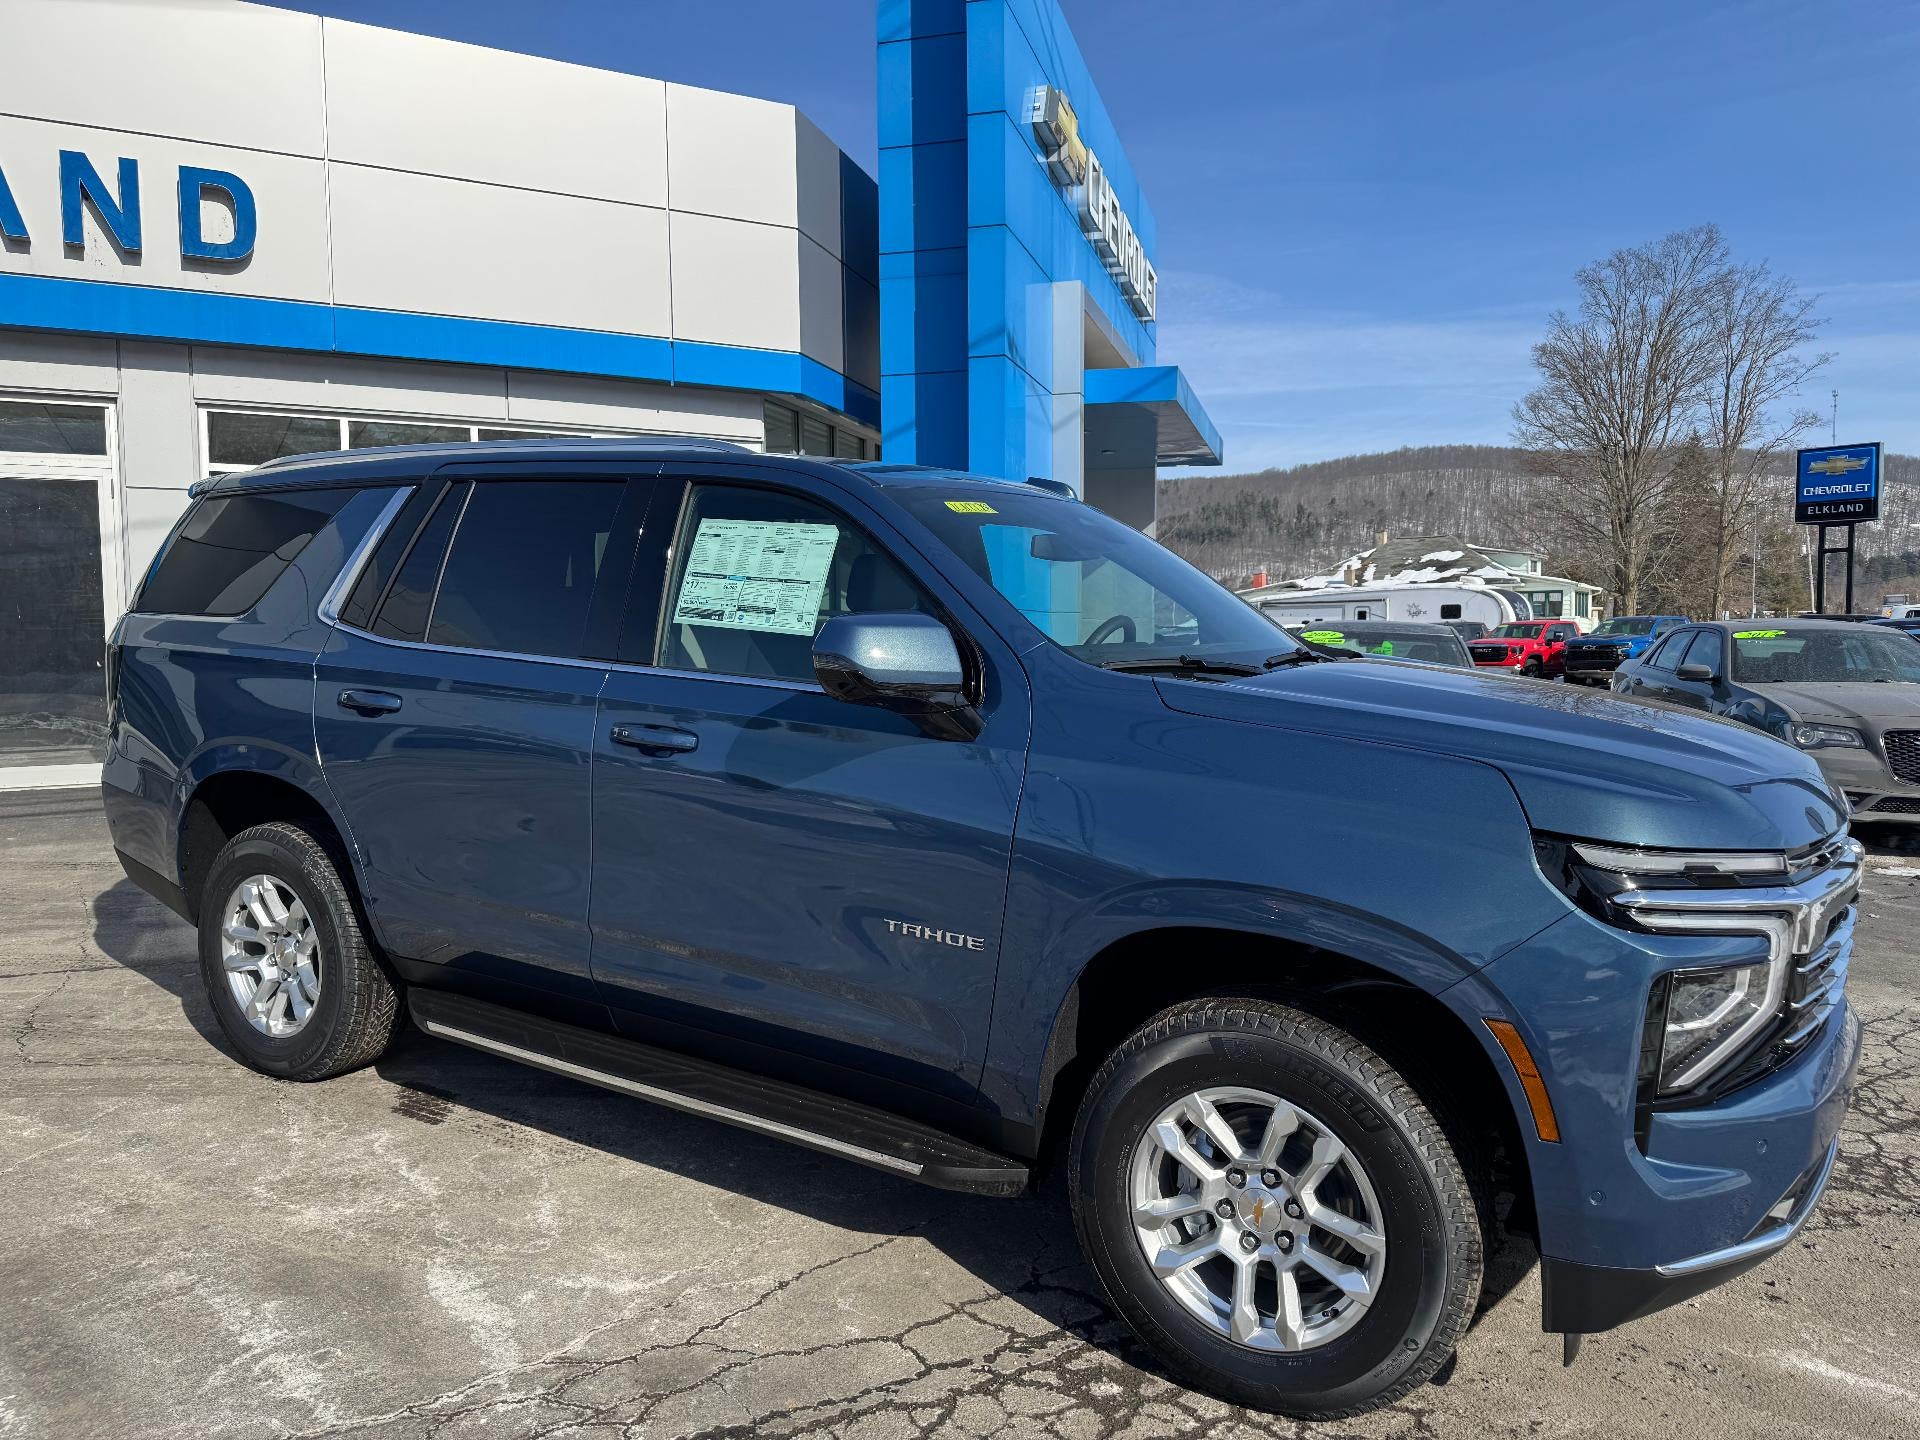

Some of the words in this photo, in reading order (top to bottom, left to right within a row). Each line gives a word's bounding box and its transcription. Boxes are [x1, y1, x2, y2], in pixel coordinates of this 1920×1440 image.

[1803, 483, 1871, 496] CHEVROLET
[1807, 503, 1864, 515] ELKLAND
[883, 917, 985, 951] TAHOE
